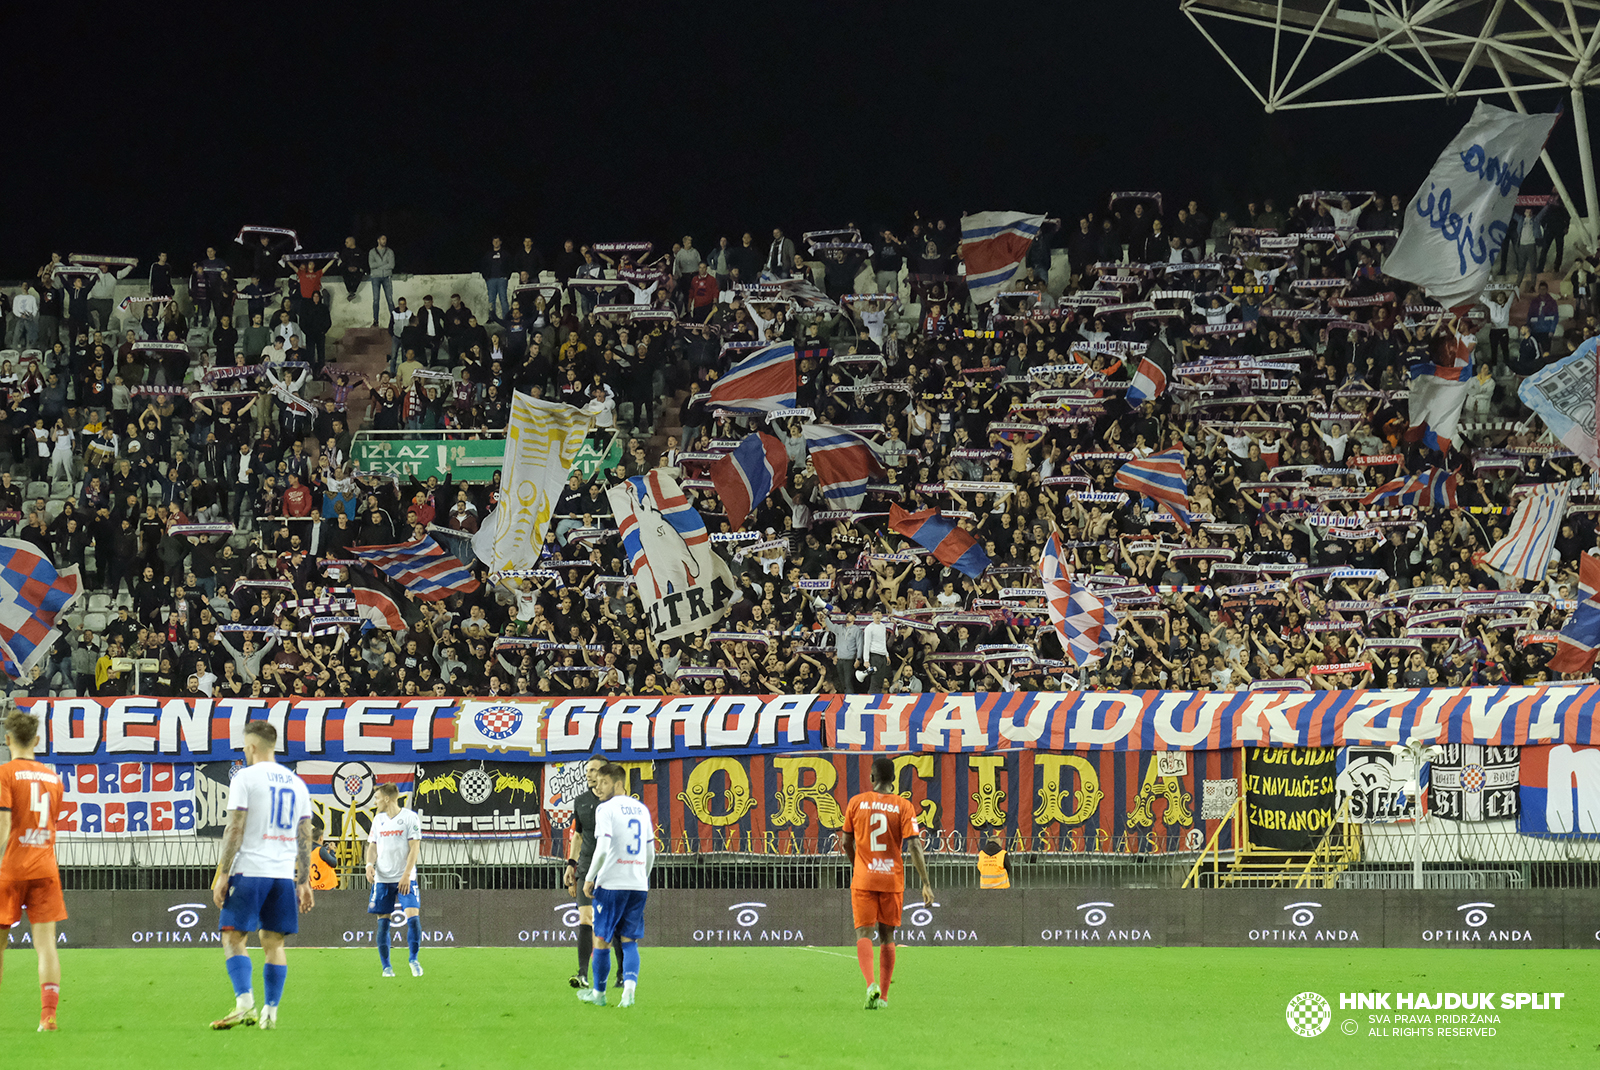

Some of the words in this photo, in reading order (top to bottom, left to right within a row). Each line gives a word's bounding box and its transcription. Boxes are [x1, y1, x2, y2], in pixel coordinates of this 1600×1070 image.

[213, 365, 255, 379] HAJDUK
[1031, 364, 1083, 375] HAJDUK
[776, 408, 806, 416] HAJDUK
[361, 445, 429, 458] IZLAZ
[1366, 455, 1398, 463] BENFICA
[369, 461, 422, 476] EXIT
[713, 532, 759, 541] HAJDUK
[1335, 530, 1376, 538] TORCIDA
[799, 580, 830, 588] MCMXI
[1340, 661, 1366, 669] BENFICA
[27, 699, 455, 754] IDENTITET
[546, 694, 818, 752] GRADA
[836, 690, 1317, 747] HAJDUK
[481, 727, 514, 739] SPLIT
[55, 762, 195, 794] TORCIDA
[1262, 775, 1319, 797] NAVIJAČE
[1320, 776, 1334, 795] SA
[30, 782, 51, 829] 4
[269, 786, 296, 830] 10
[860, 800, 871, 811] M.
[872, 801, 900, 814] MUSA
[55, 799, 195, 833] ZAGREB
[418, 808, 541, 832] torcida
[1250, 803, 1332, 831] ZABRANOM
[626, 818, 643, 856] 3
[870, 812, 889, 852] 2
[132, 931, 191, 943] OPTIKA
[518, 930, 578, 942] OPTIKA
[693, 929, 752, 942] OPTIKA
[760, 929, 804, 942] ANDA
[933, 929, 978, 942] ANDA
[1041, 929, 1100, 942] OPTIKA
[1107, 929, 1152, 942] ANDA
[1248, 929, 1307, 942] OPTIKA
[1315, 929, 1360, 942] ANDA
[1422, 929, 1480, 942] OPTIKA
[1488, 929, 1533, 942] ANDA
